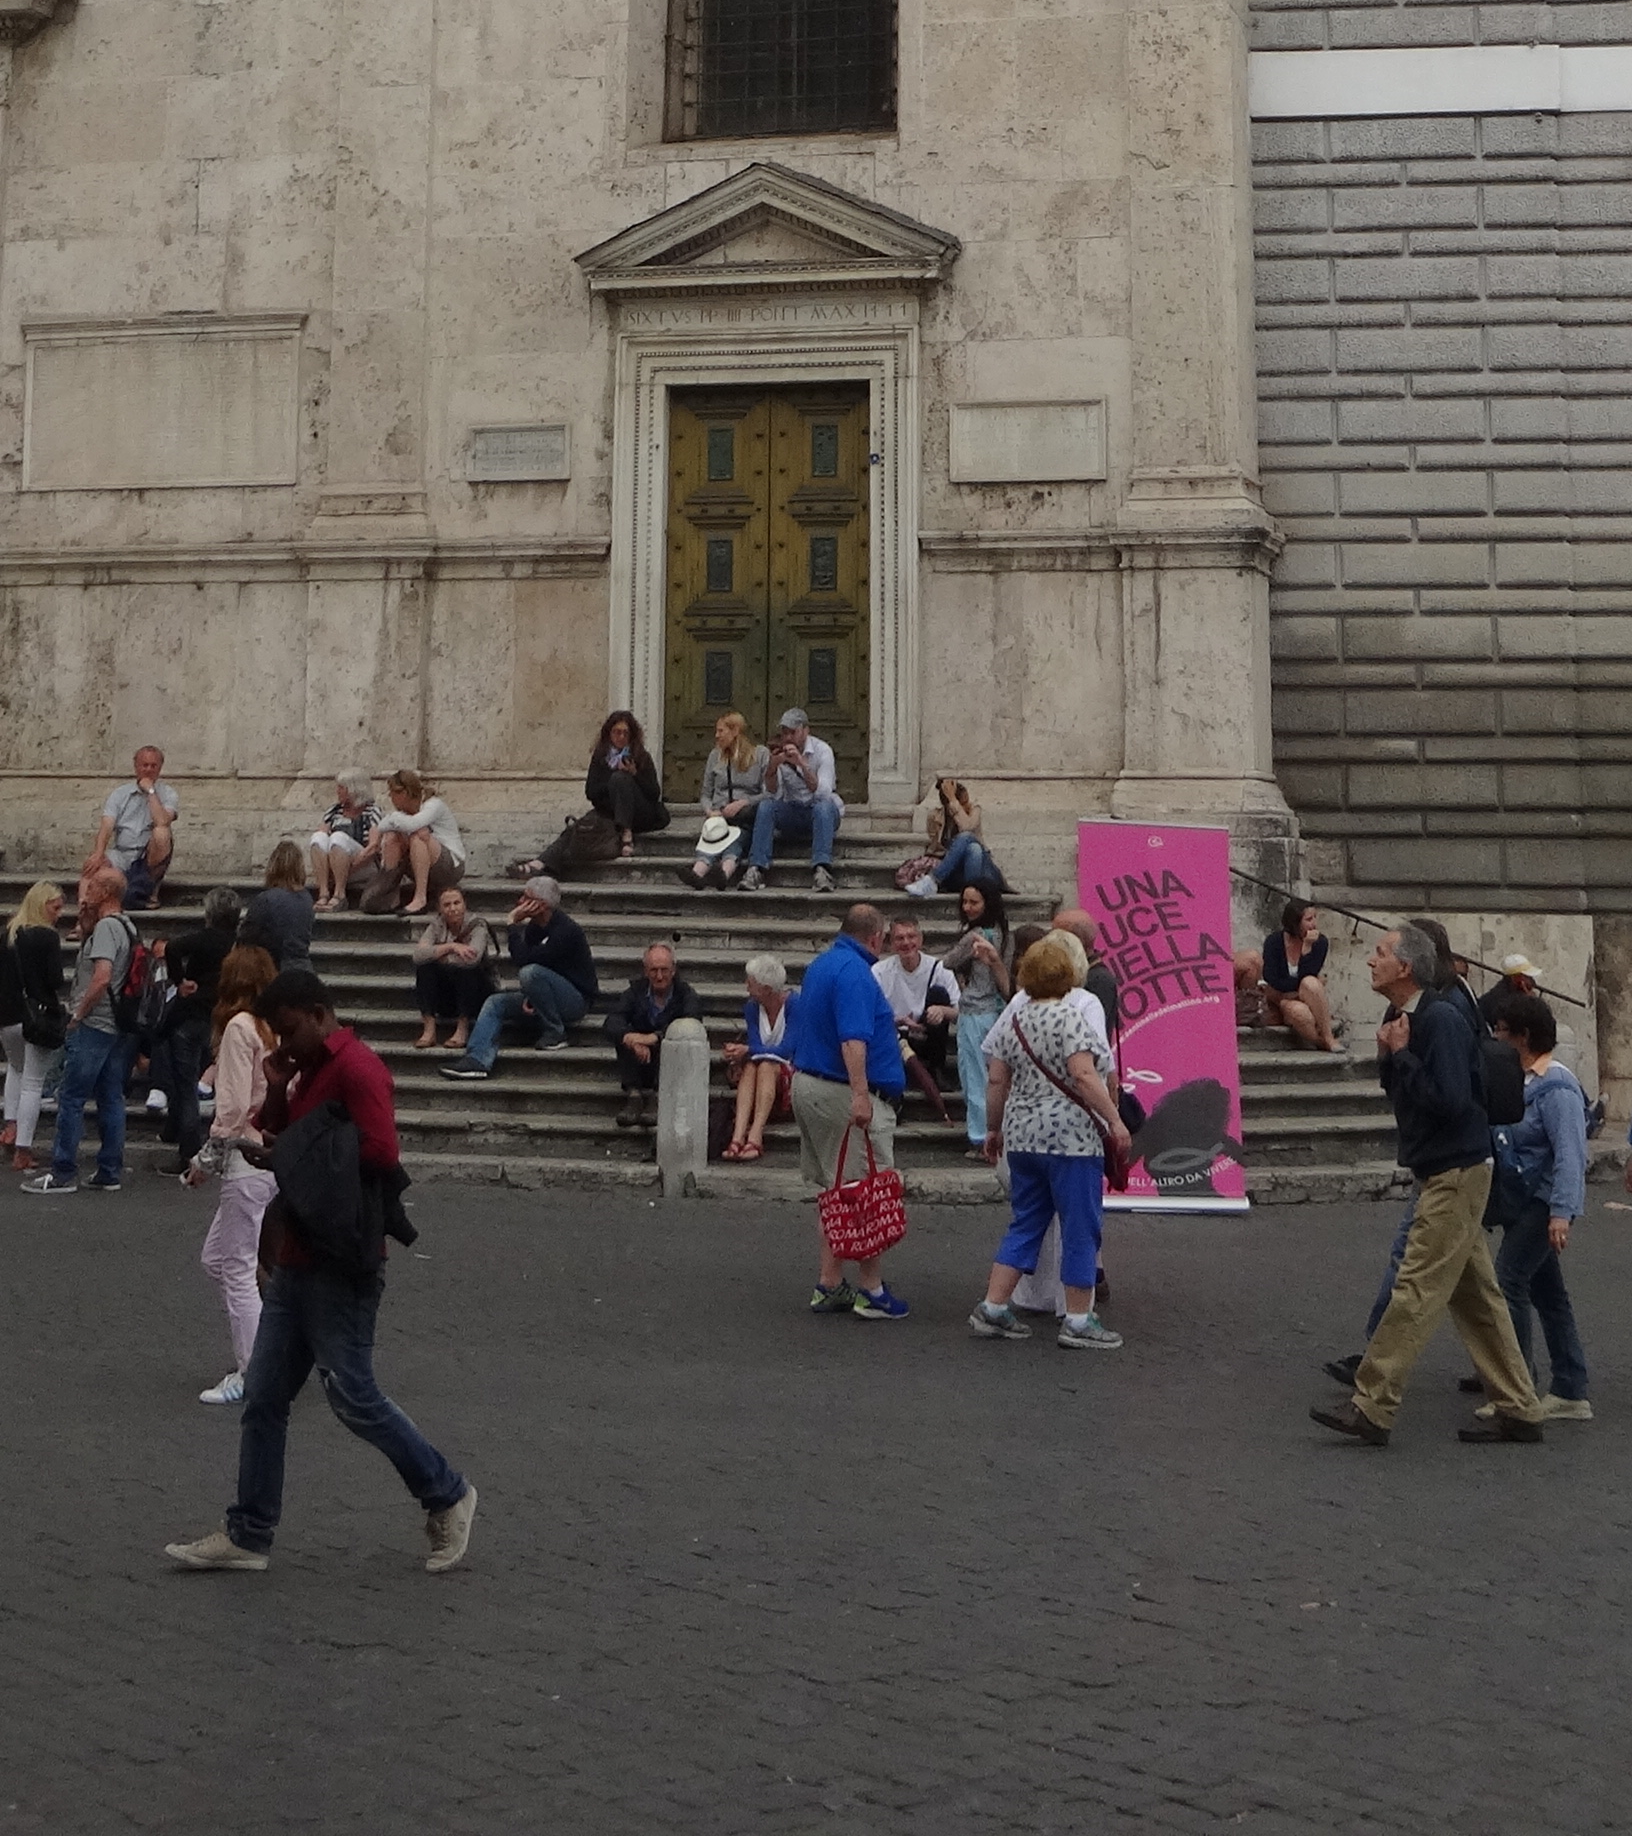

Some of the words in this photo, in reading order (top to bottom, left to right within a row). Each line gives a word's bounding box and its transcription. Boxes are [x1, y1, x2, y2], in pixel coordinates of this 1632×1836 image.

[1095, 869, 1196, 912] UNA
[1092, 900, 1191, 961] UCE
[1117, 963, 1229, 1030] OTTE
[1186, 1172, 1203, 1186] DA
[1202, 1155, 1237, 1178] VIVERE
